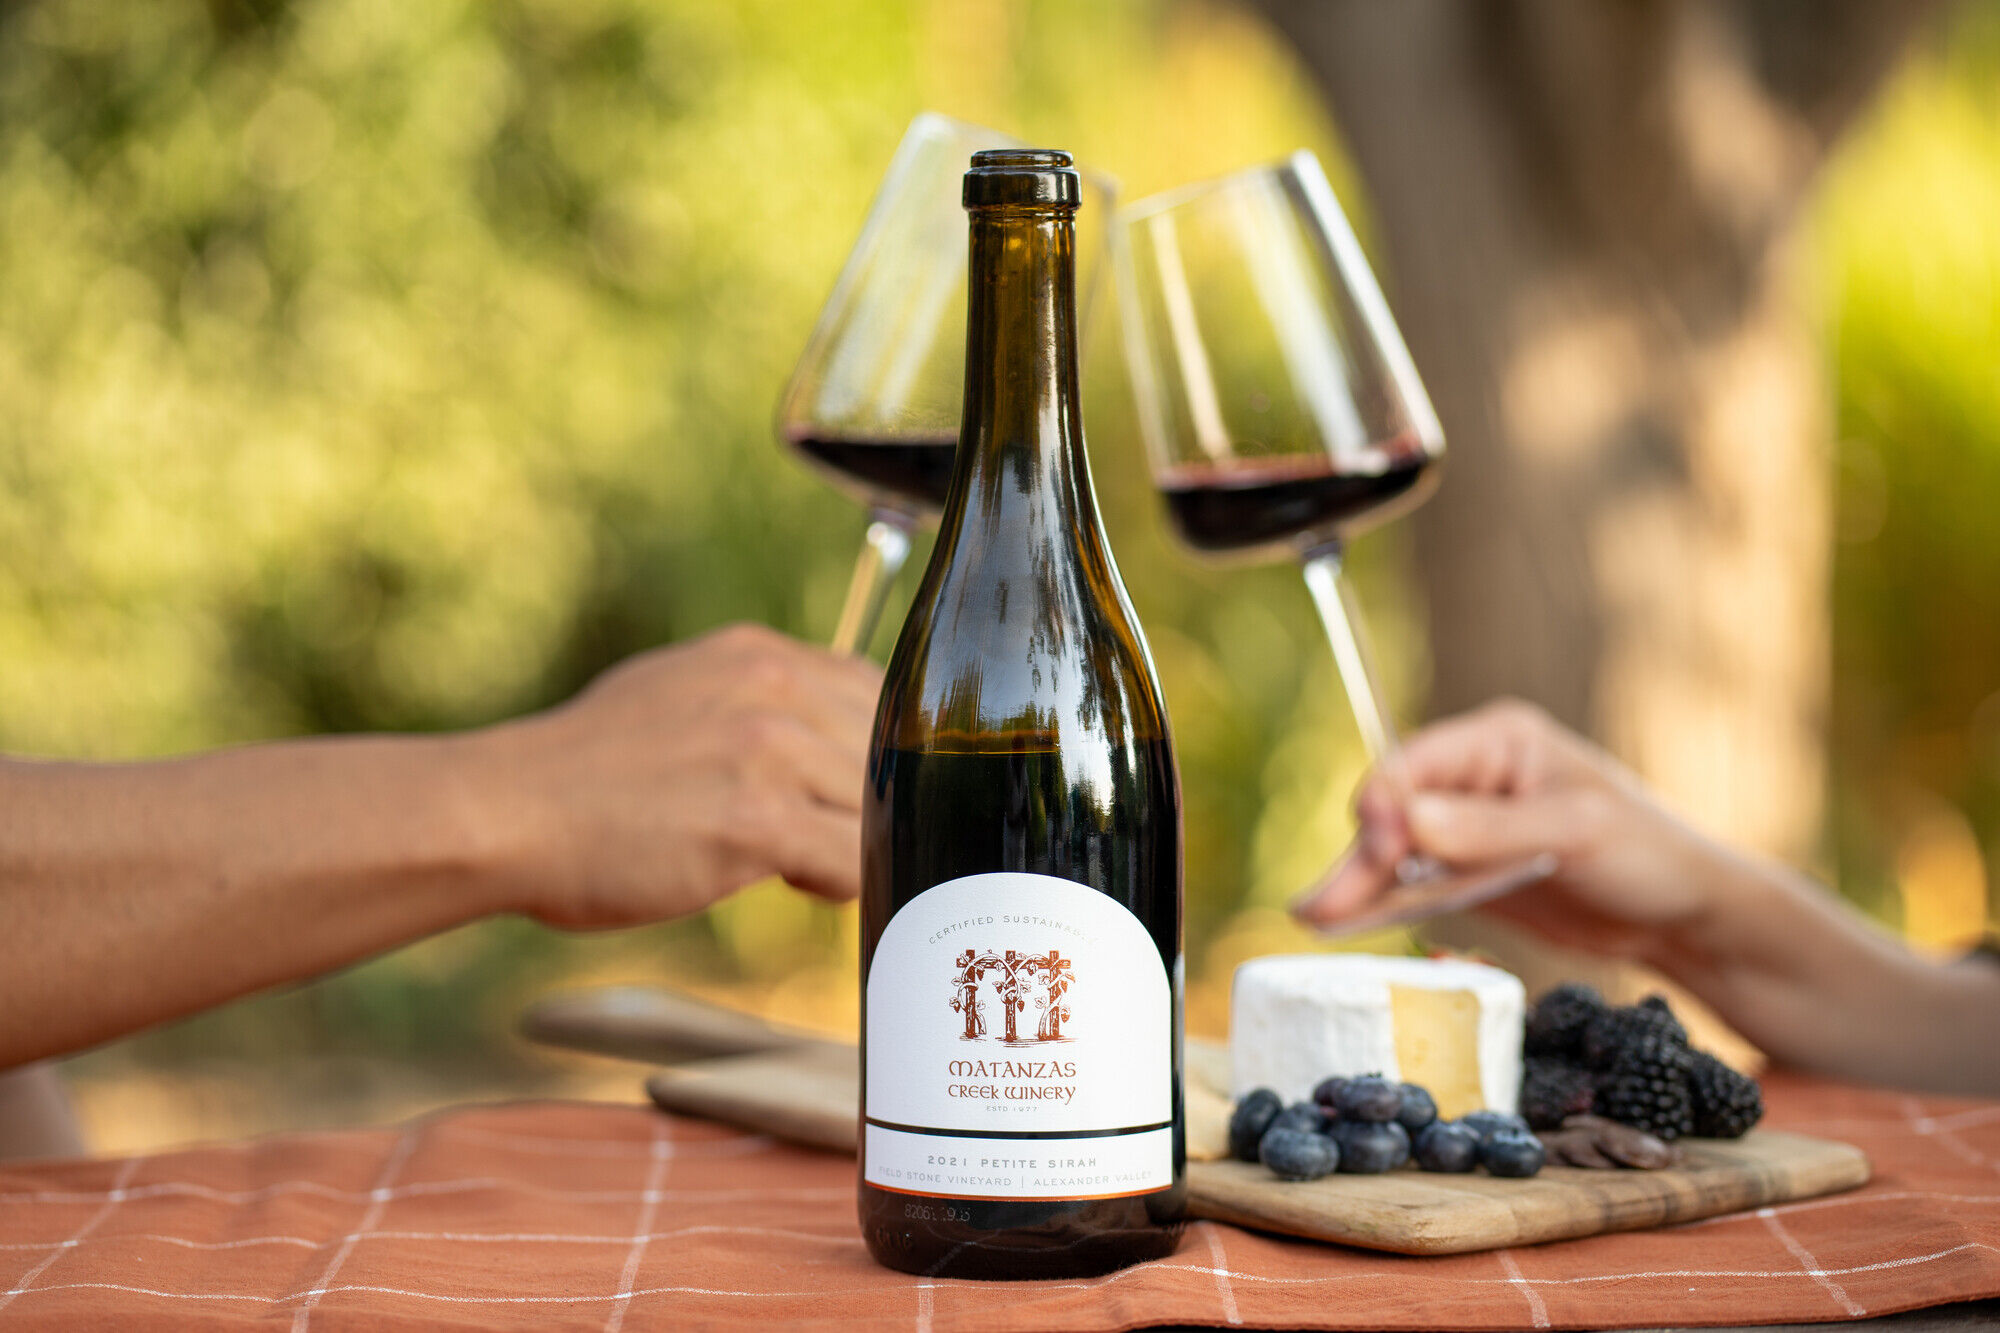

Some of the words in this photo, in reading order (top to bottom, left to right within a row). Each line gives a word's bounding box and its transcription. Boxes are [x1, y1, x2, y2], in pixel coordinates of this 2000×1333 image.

[929, 916, 994, 945] CERTIFIED
[1003, 915, 1097, 946] SUSTAINA
[948, 1060, 1077, 1078] MATANZAS
[1004, 1086, 1076, 1106] WINERY
[927, 1155, 967, 1167] 2021
[981, 1158, 1037, 1169] PETITE
[1048, 1158, 1097, 1169] SIRAH
[879, 1166, 902, 1178] FIELD
[907, 1171, 941, 1183] STONE
[948, 1176, 1012, 1186] VINEYARD
[1033, 1176, 1109, 1187] ALEXANDER
